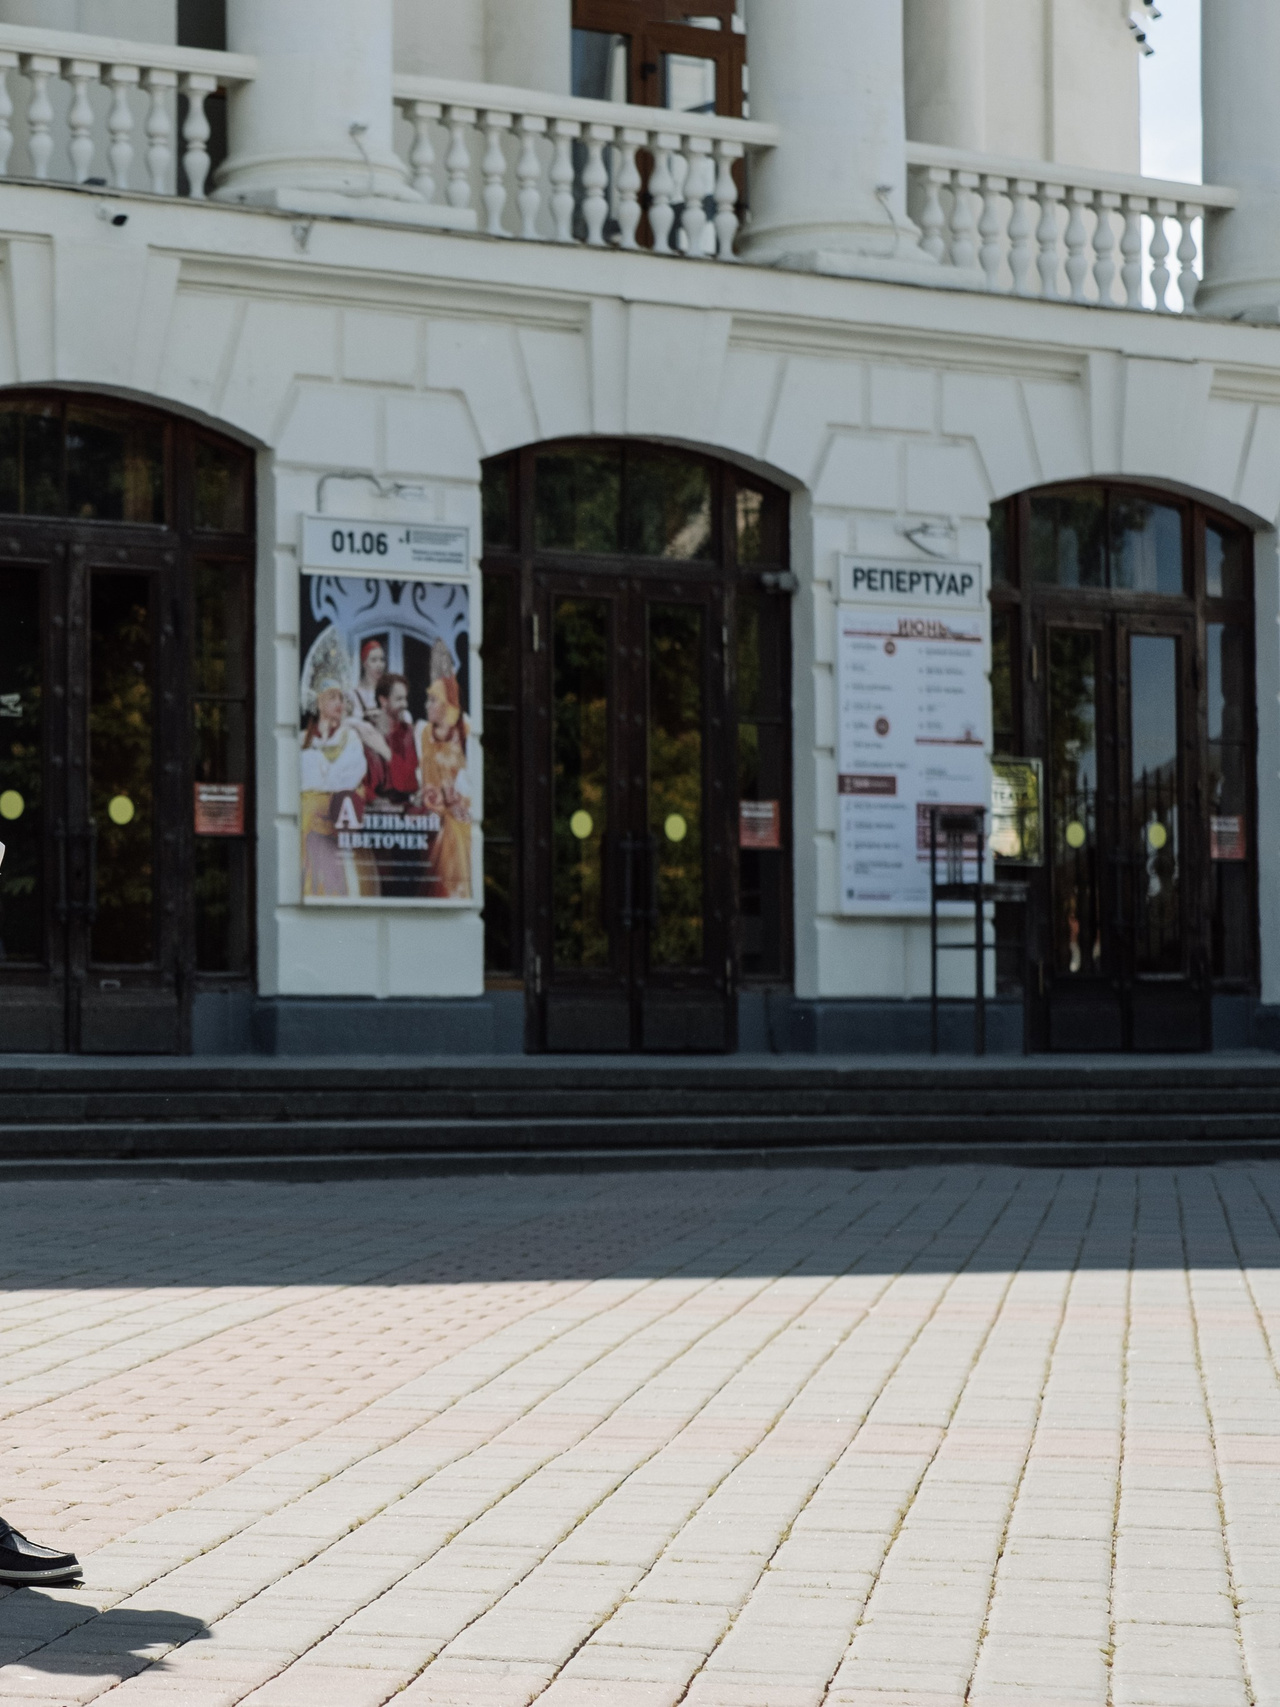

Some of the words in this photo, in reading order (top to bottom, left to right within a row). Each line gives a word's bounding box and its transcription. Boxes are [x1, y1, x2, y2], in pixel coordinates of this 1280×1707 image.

[332, 530, 388, 555] 01.06
[853, 567, 973, 596] РЕПЕРТУАР
[898, 617, 948, 639] ИЮНЬ
[338, 832, 428, 849] ЦВЕТОЧЕК
